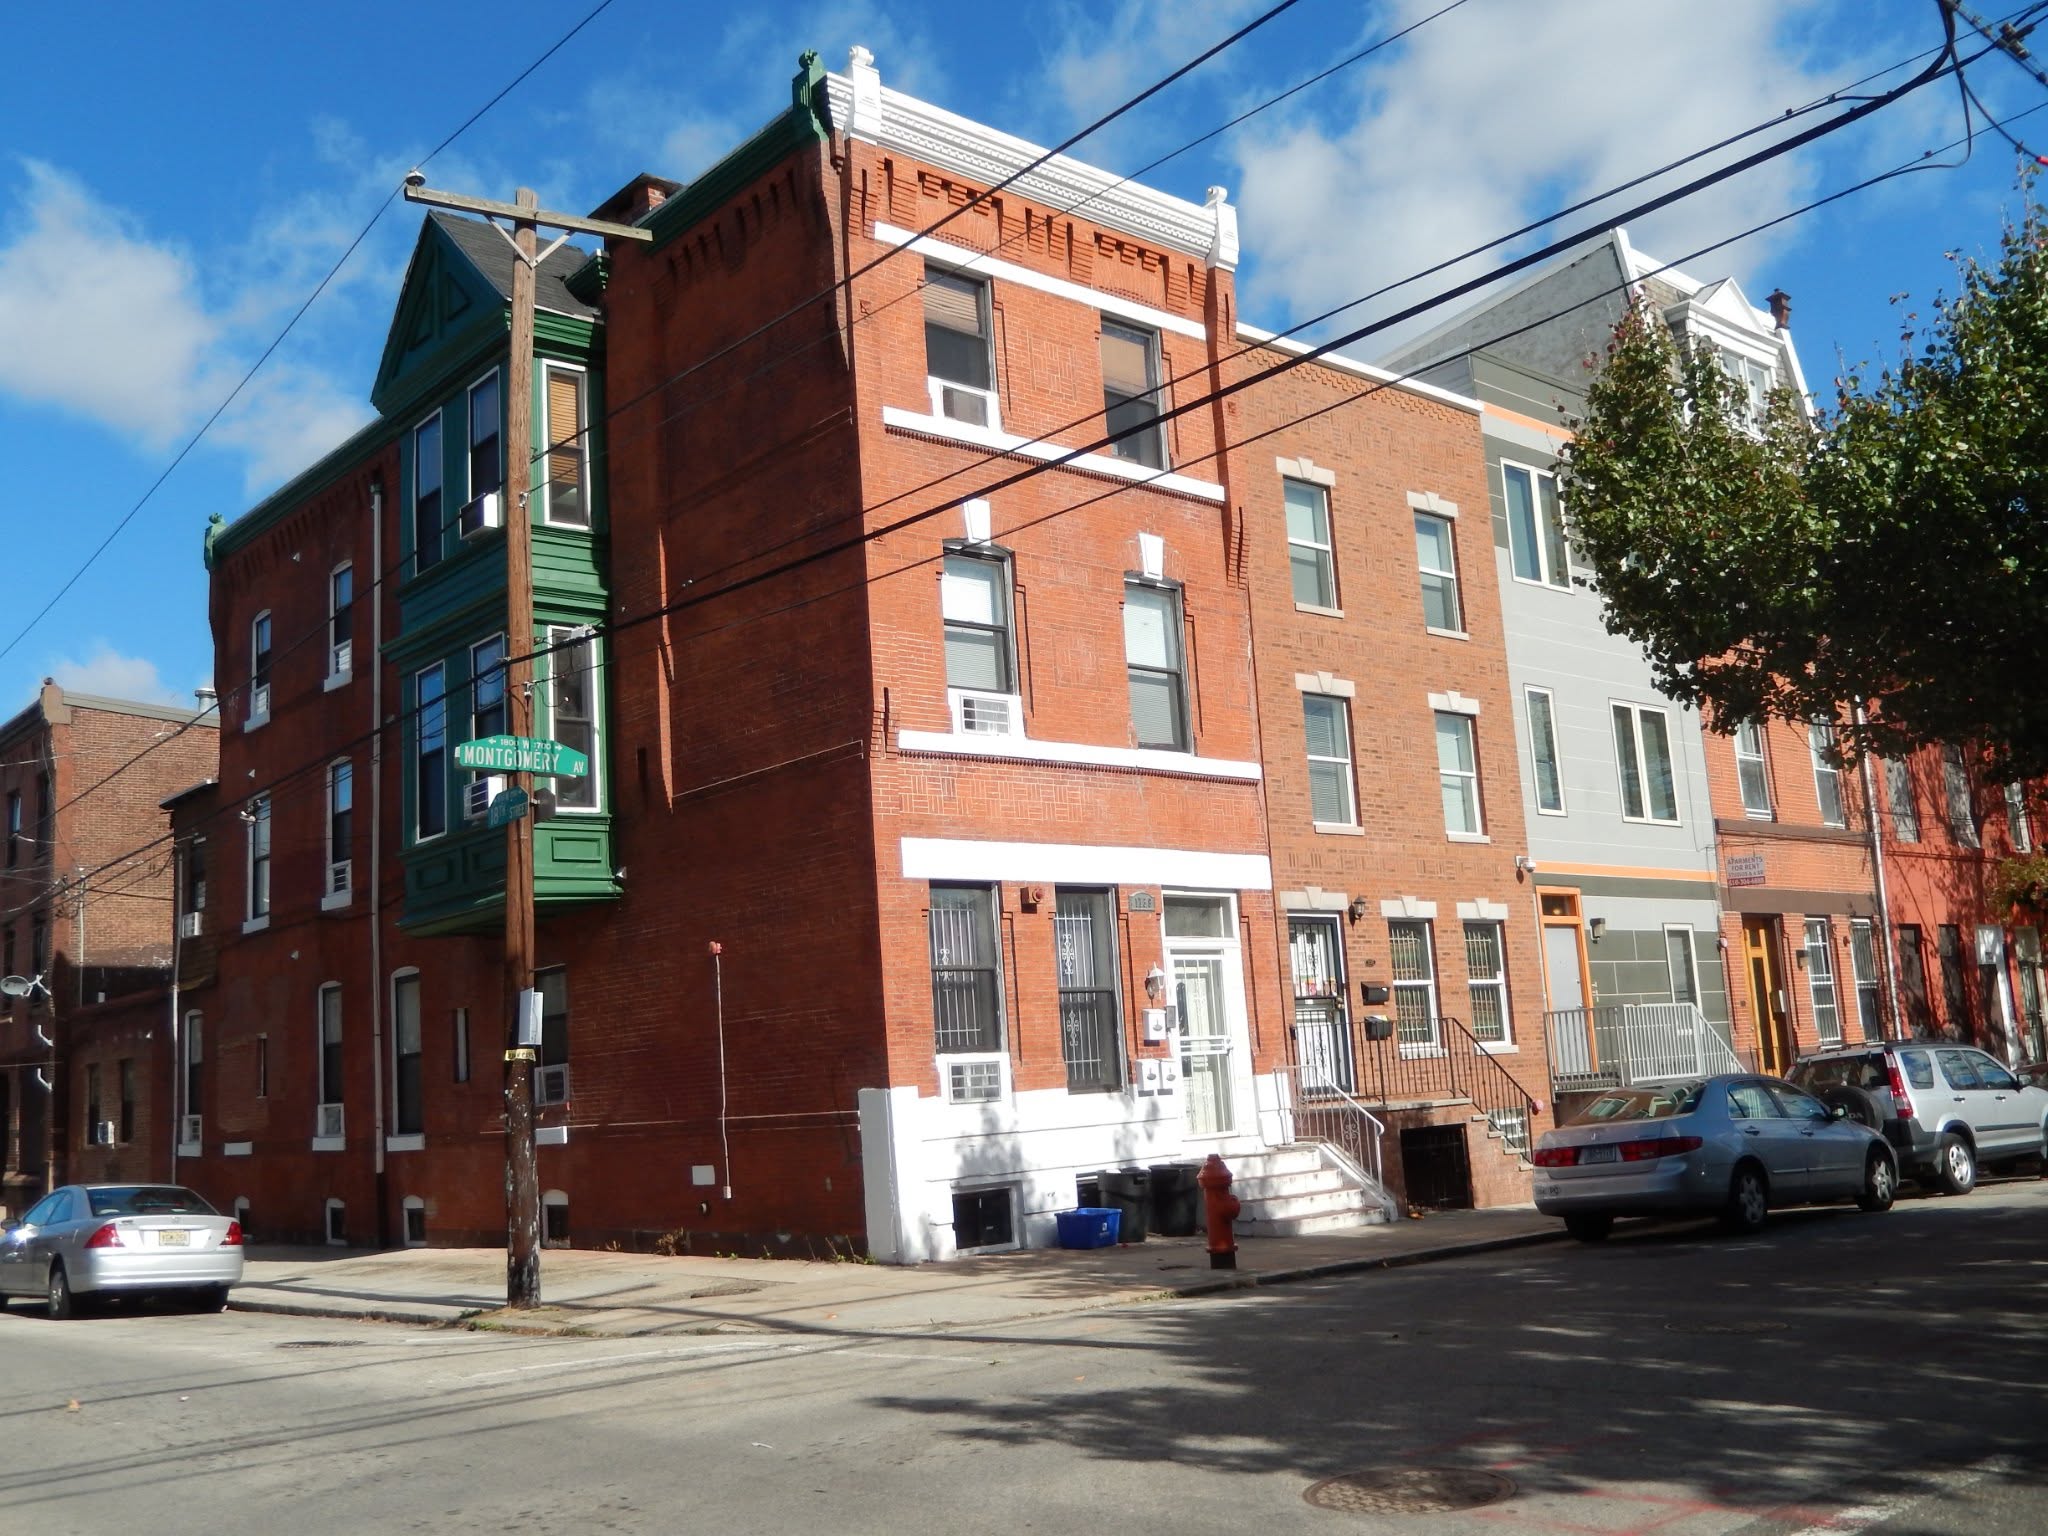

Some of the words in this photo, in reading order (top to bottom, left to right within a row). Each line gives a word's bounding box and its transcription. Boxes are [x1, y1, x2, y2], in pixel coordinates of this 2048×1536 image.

[522, 739, 529, 749] W
[464, 746, 560, 771] MONTGOMERY
[573, 761, 584, 773] AV
